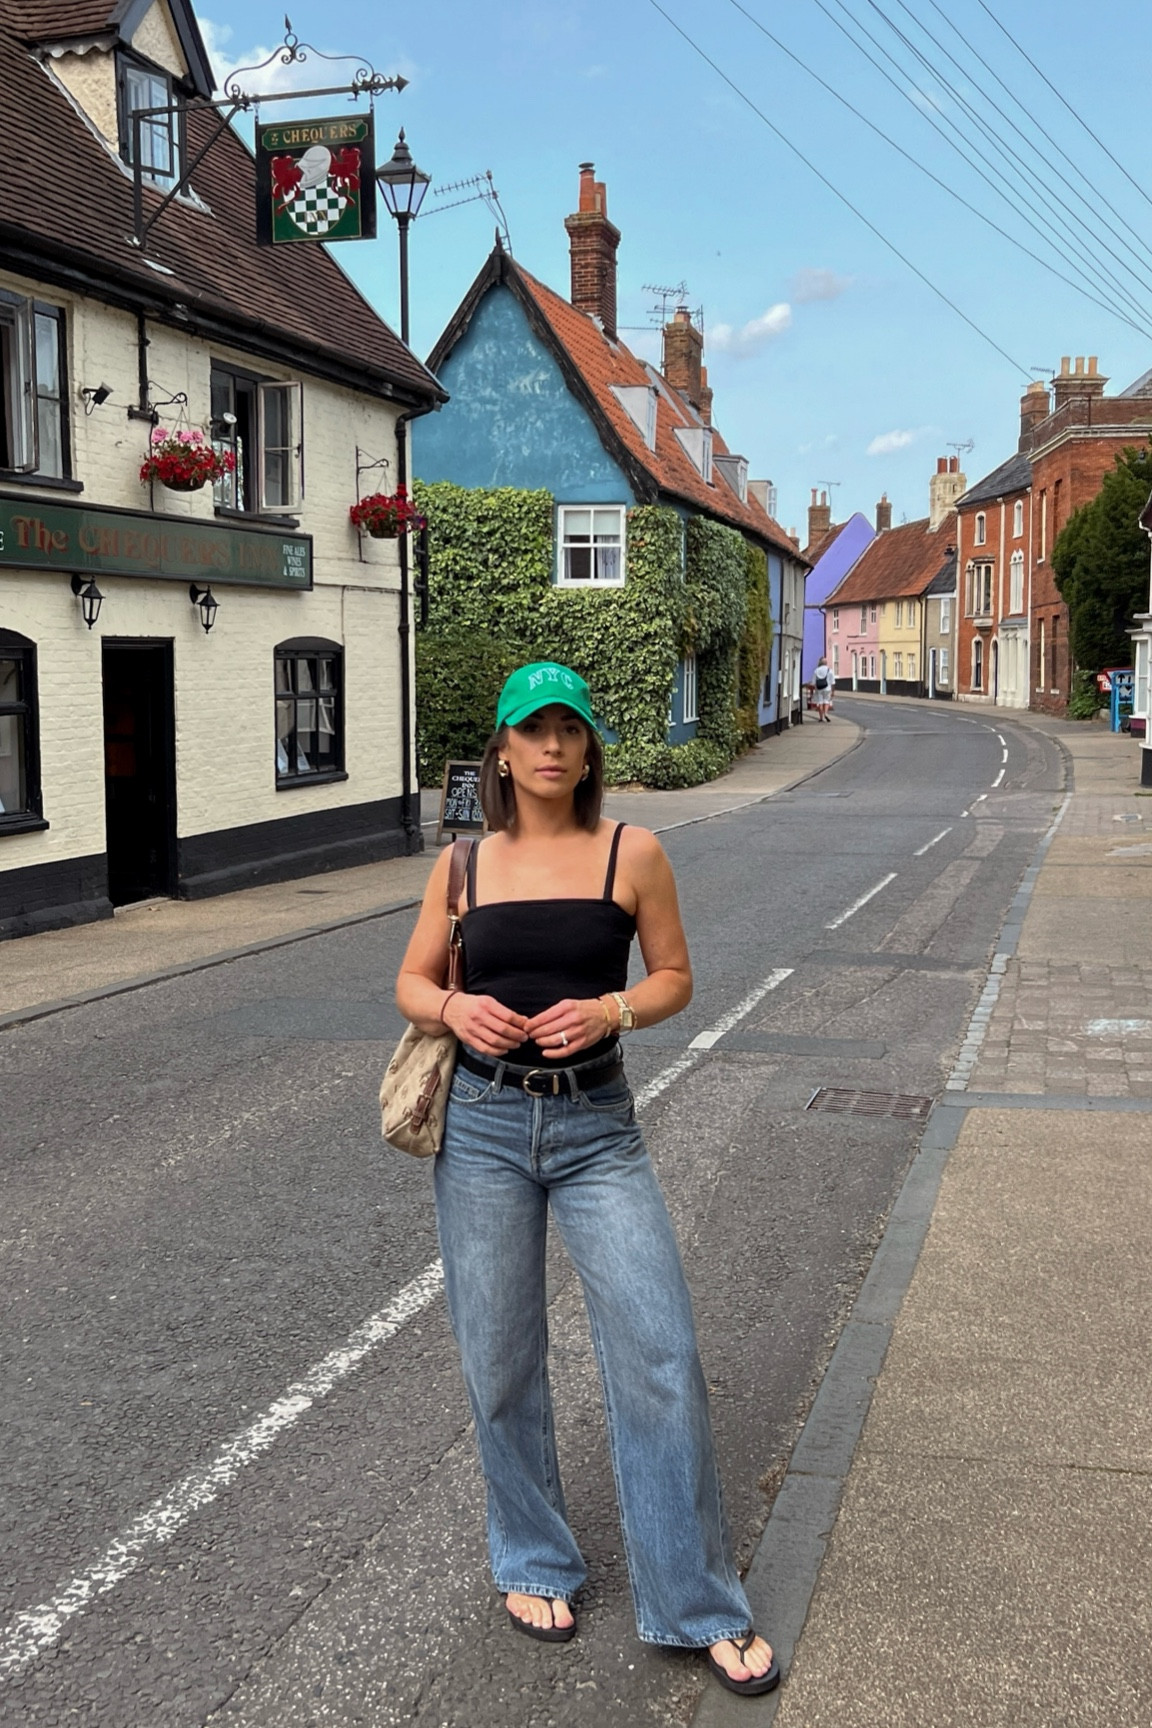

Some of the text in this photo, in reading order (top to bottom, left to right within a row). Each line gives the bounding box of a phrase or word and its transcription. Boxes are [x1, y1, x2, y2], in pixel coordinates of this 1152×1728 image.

[282, 123, 357, 144] CHEQUERS
[10, 515, 69, 556] The
[78, 525, 231, 572] CHEQUERS
[282, 544, 293, 556] FINE
[528, 667, 574, 691] NYC
[451, 787, 477, 798] OPENS
